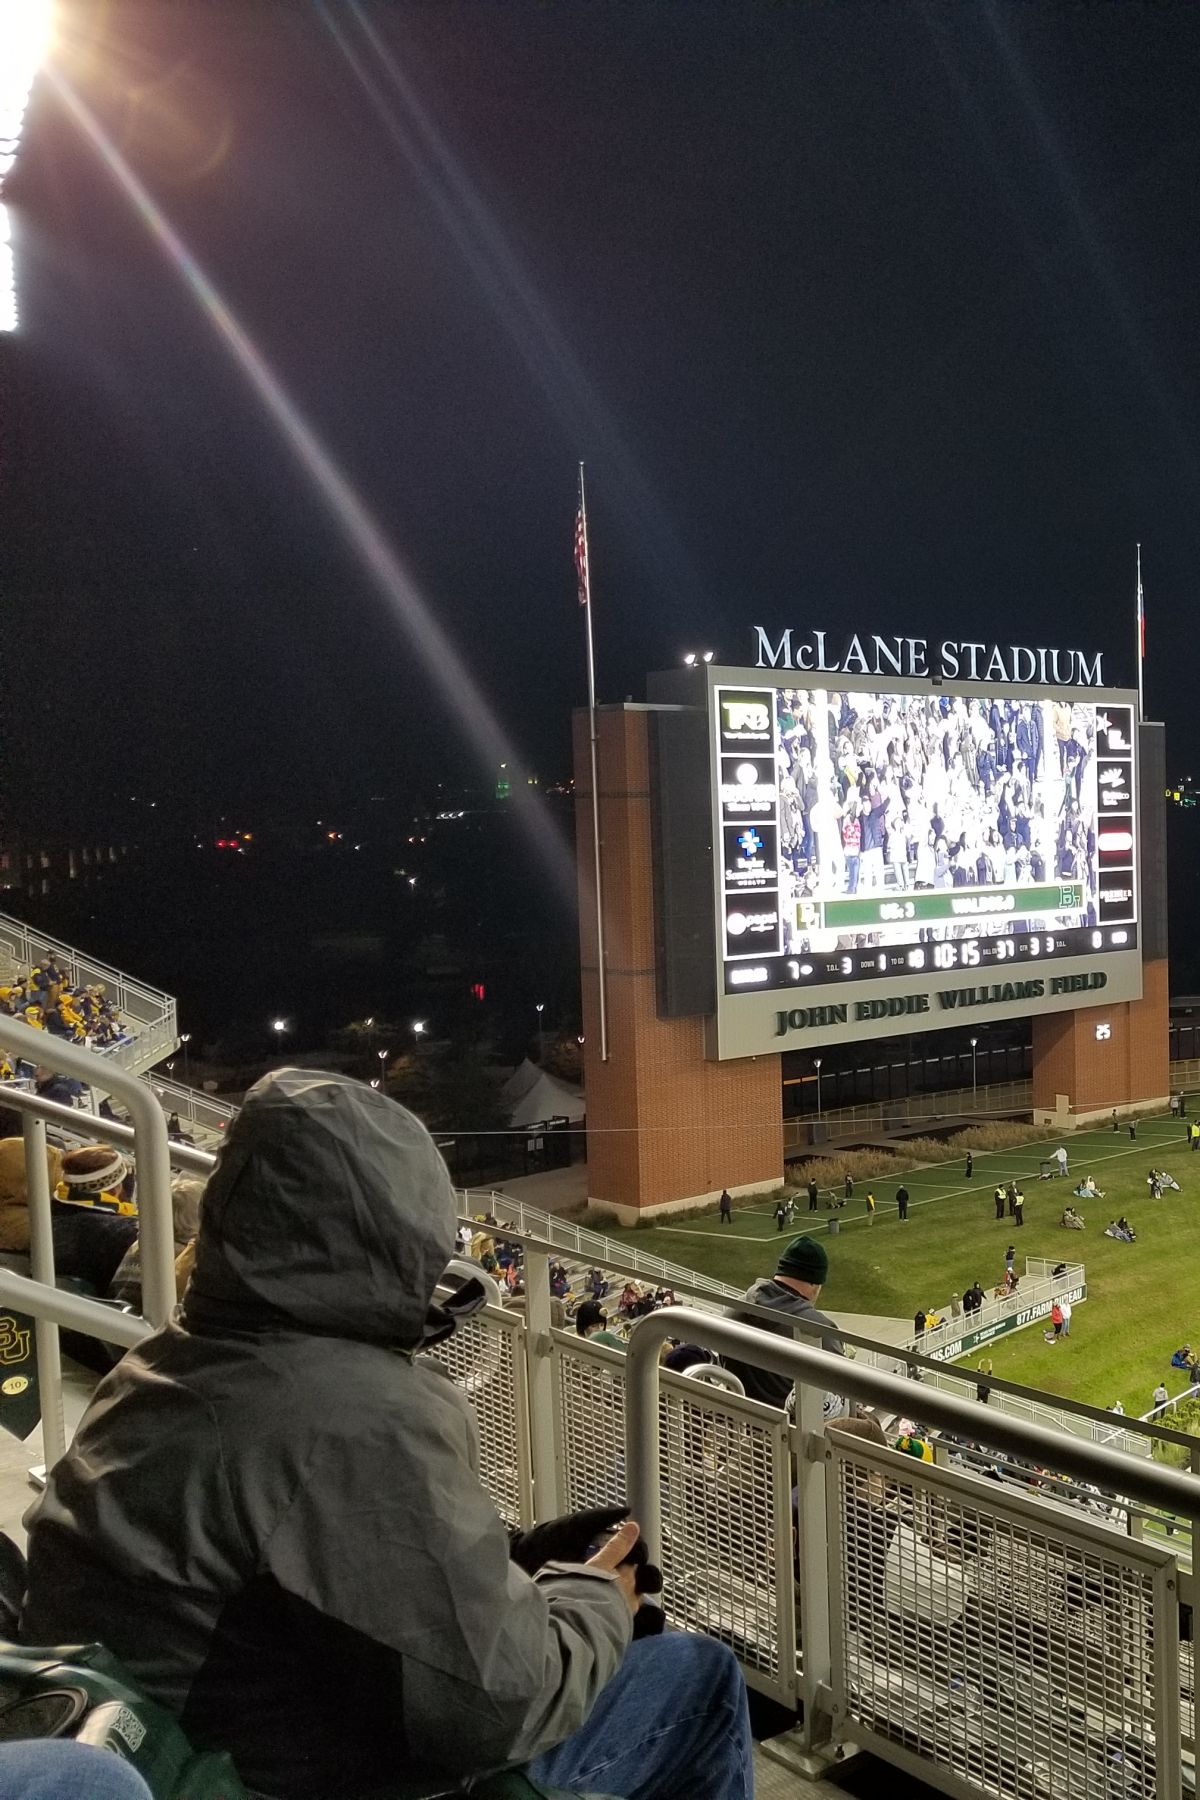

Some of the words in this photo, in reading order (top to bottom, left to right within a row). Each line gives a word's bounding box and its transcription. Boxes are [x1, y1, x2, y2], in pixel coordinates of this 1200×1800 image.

[753, 626, 929, 677] McLANE
[940, 640, 1105, 687] STADIUM
[1029, 937, 1040, 956] 3
[1046, 936, 1055, 953] 3
[933, 940, 981, 969] 10:15
[840, 956, 853, 975] 3
[860, 960, 875, 969] DOWN
[774, 1003, 848, 1037] JOHN
[854, 993, 930, 1021] EDDIE
[936, 979, 1045, 1010] WILLIAMS
[1049, 971, 1108, 995] FIELD
[10, 1381, 22, 1390] 10
